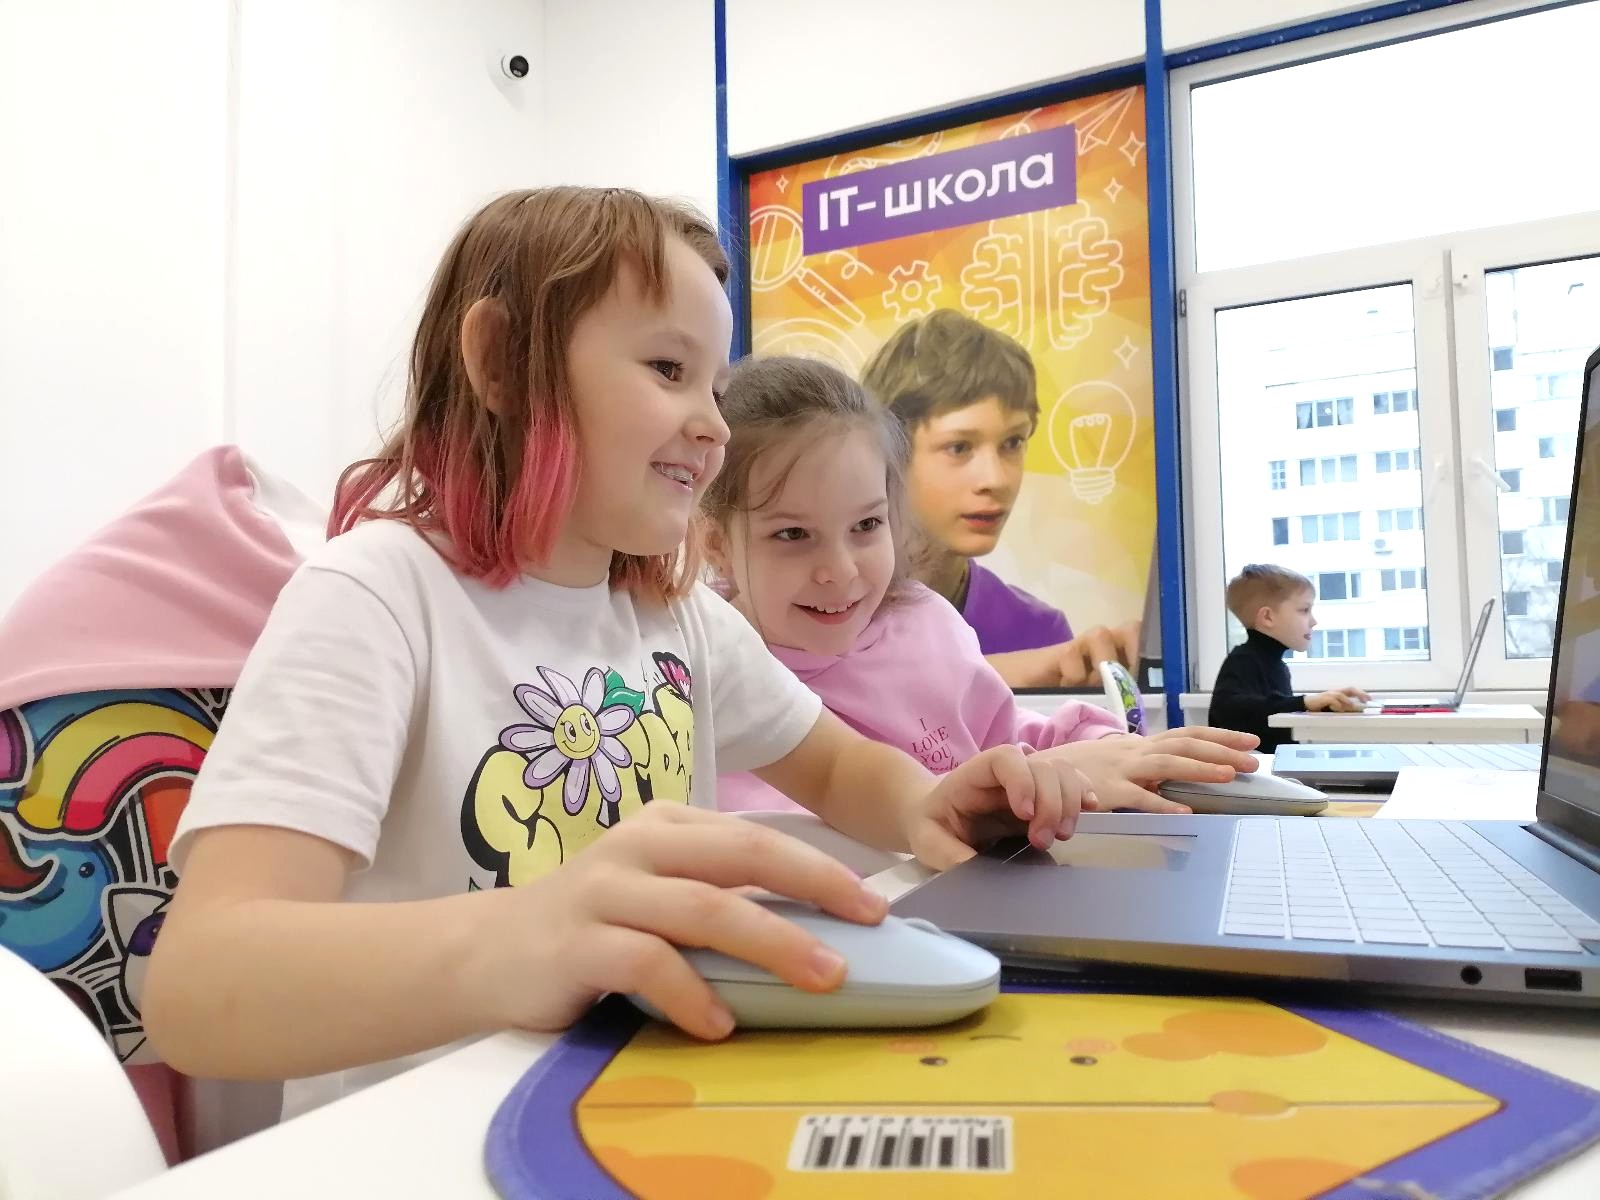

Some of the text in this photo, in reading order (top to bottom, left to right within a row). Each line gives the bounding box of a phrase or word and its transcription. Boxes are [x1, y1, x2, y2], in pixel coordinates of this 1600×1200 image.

[818, 152, 1055, 231] IT-школа
[919, 718, 928, 732] I
[912, 726, 949, 754] LOVE
[920, 743, 952, 764] YOU
